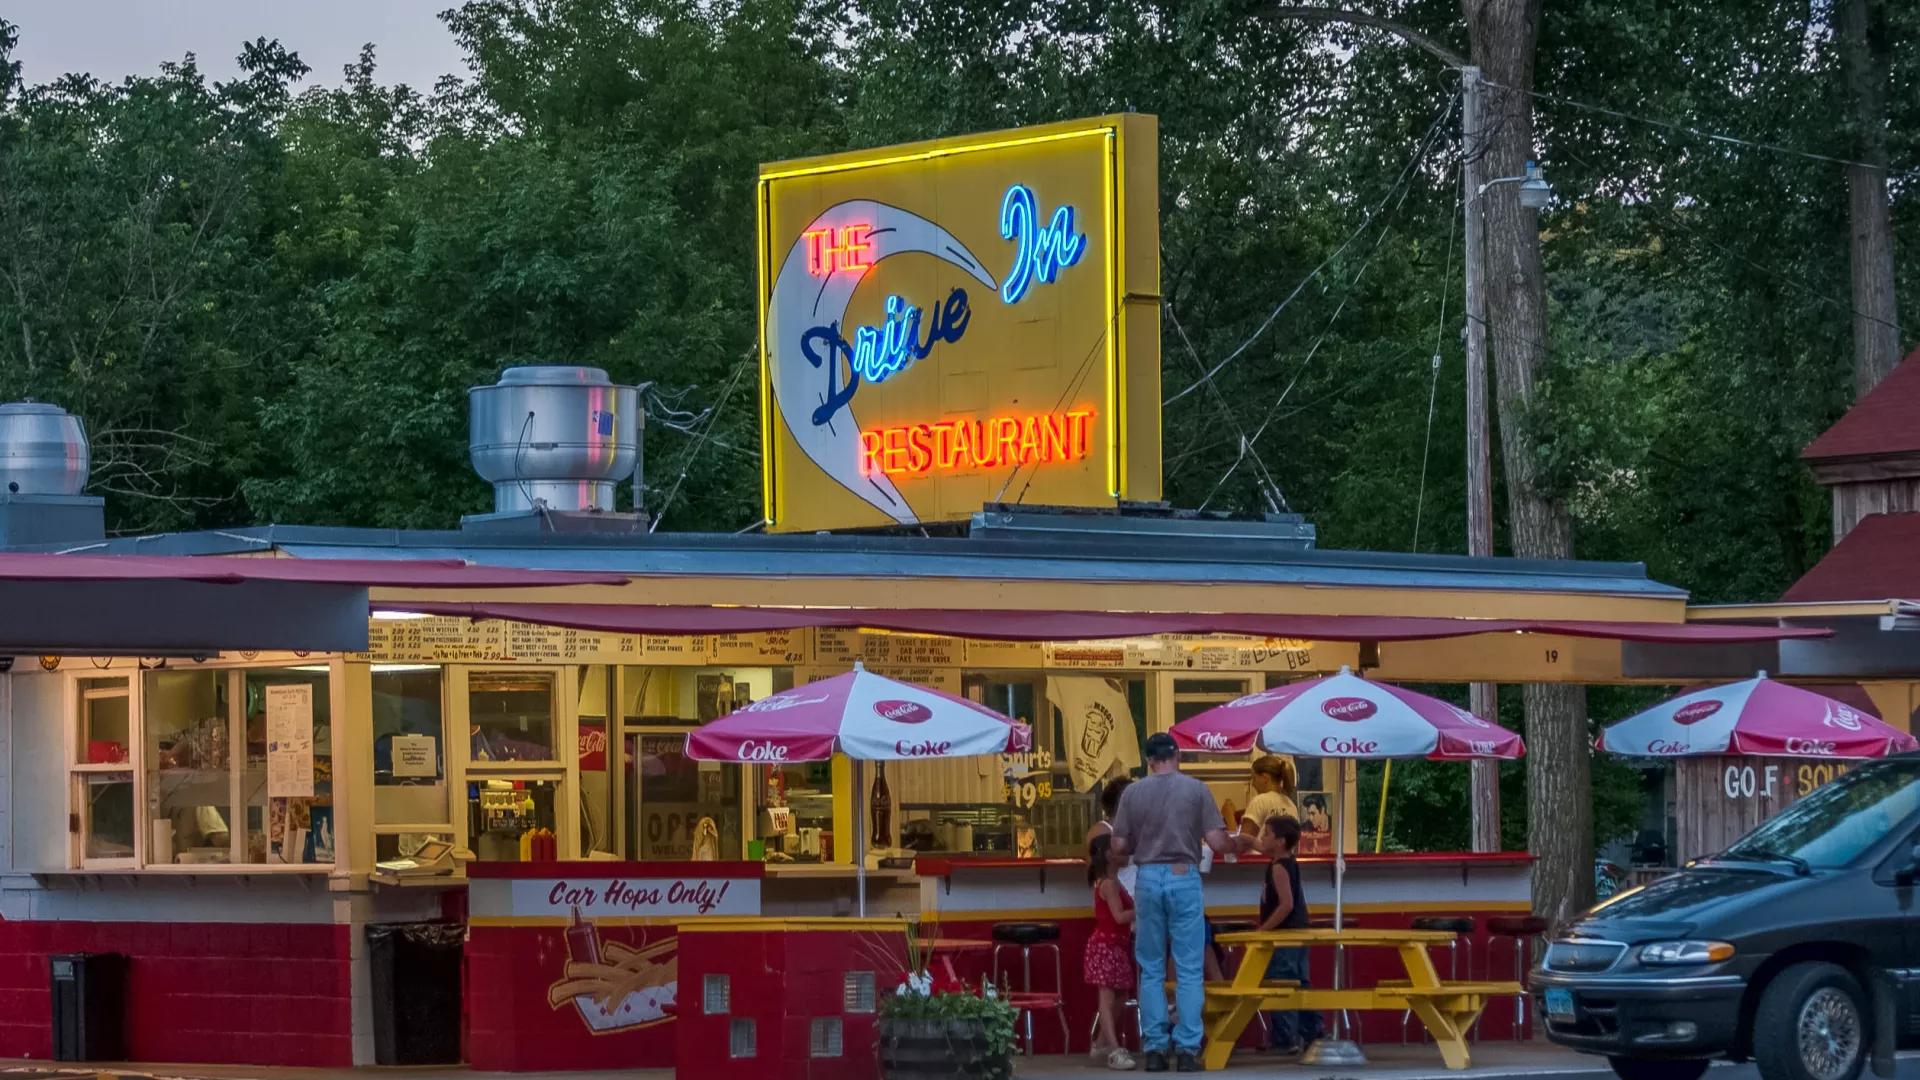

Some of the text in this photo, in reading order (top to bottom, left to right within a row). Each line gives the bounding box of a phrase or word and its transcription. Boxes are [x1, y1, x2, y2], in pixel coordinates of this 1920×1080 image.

[802, 222, 874, 276] THE
[1001, 183, 1087, 304] In
[801, 287, 971, 427] Drive
[857, 409, 1095, 477] RESTAURANT
[896, 638, 917, 646] PLEASE
[930, 639, 953, 647] SEATED
[899, 647, 945, 656] CAR HOP WILL
[483, 651, 501, 660] 2.99
[896, 655, 912, 663] TAKE
[1544, 650, 1558, 663] 19
[1328, 700, 1369, 716] Coca-Cola
[737, 739, 789, 762] Coke
[895, 739, 952, 758] Coke
[1197, 732, 1229, 750] Coke
[1320, 736, 1378, 755] Coke
[1647, 738, 1692, 755] Coke
[1785, 737, 1837, 756] Coke
[1724, 764, 1779, 799] GOF
[548, 878, 731, 915] Car Hops Only!
